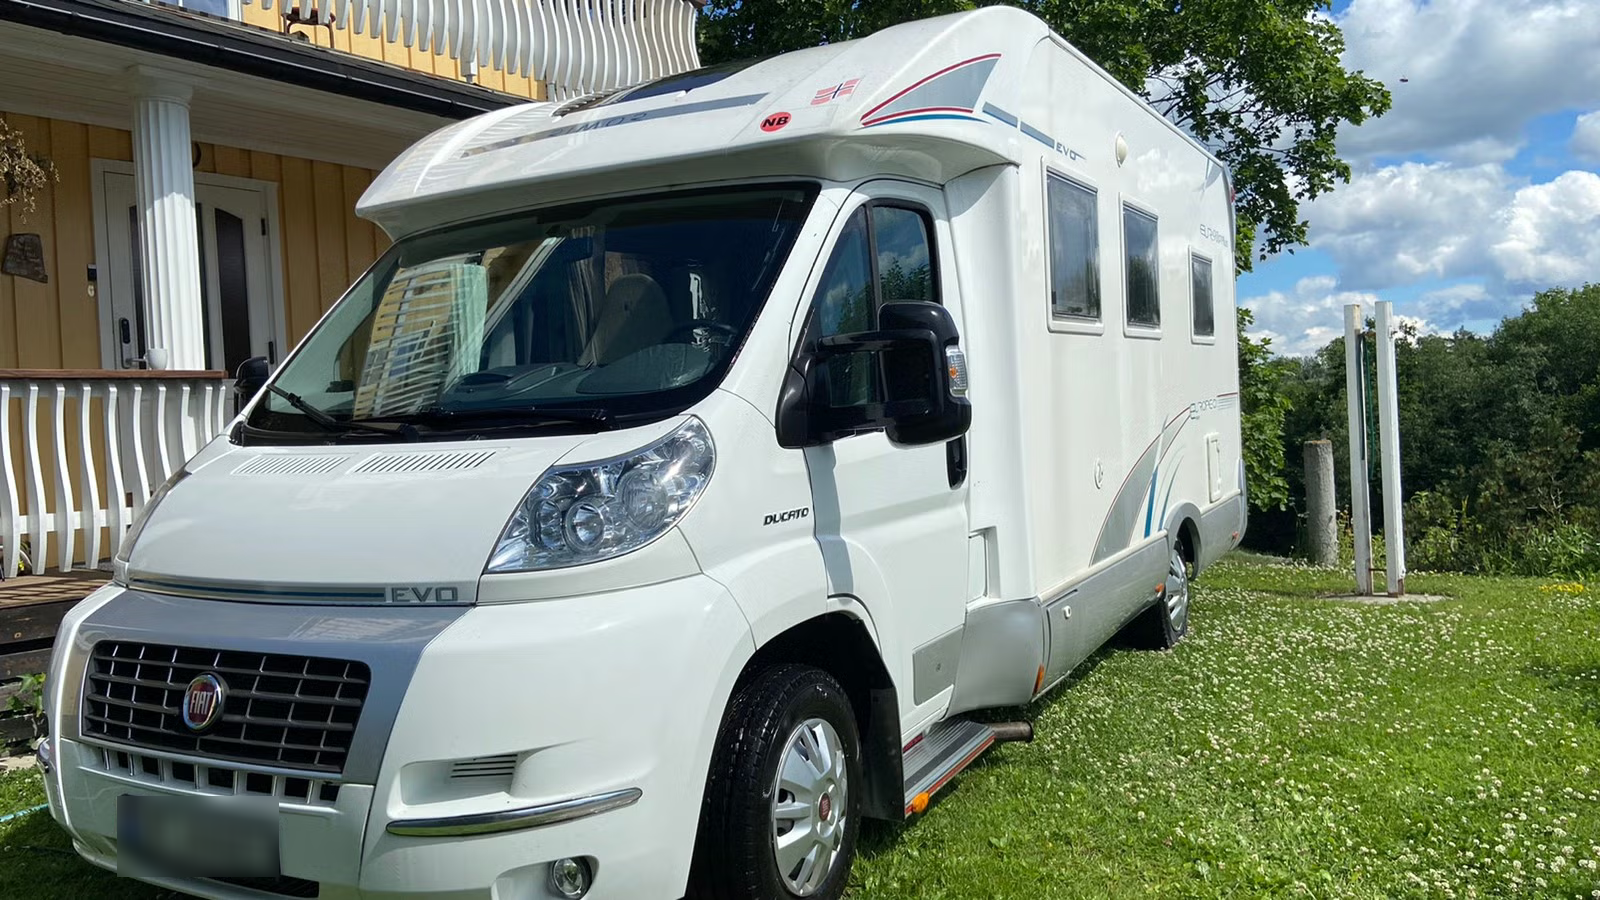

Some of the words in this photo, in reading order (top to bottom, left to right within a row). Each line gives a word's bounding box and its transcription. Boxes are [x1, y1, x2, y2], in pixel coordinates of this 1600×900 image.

[762, 116, 789, 128] NB
[1056, 142, 1084, 161] EVO
[763, 507, 809, 526] DUCATO
[391, 586, 458, 603] EVO
[189, 690, 213, 715] FIAT
